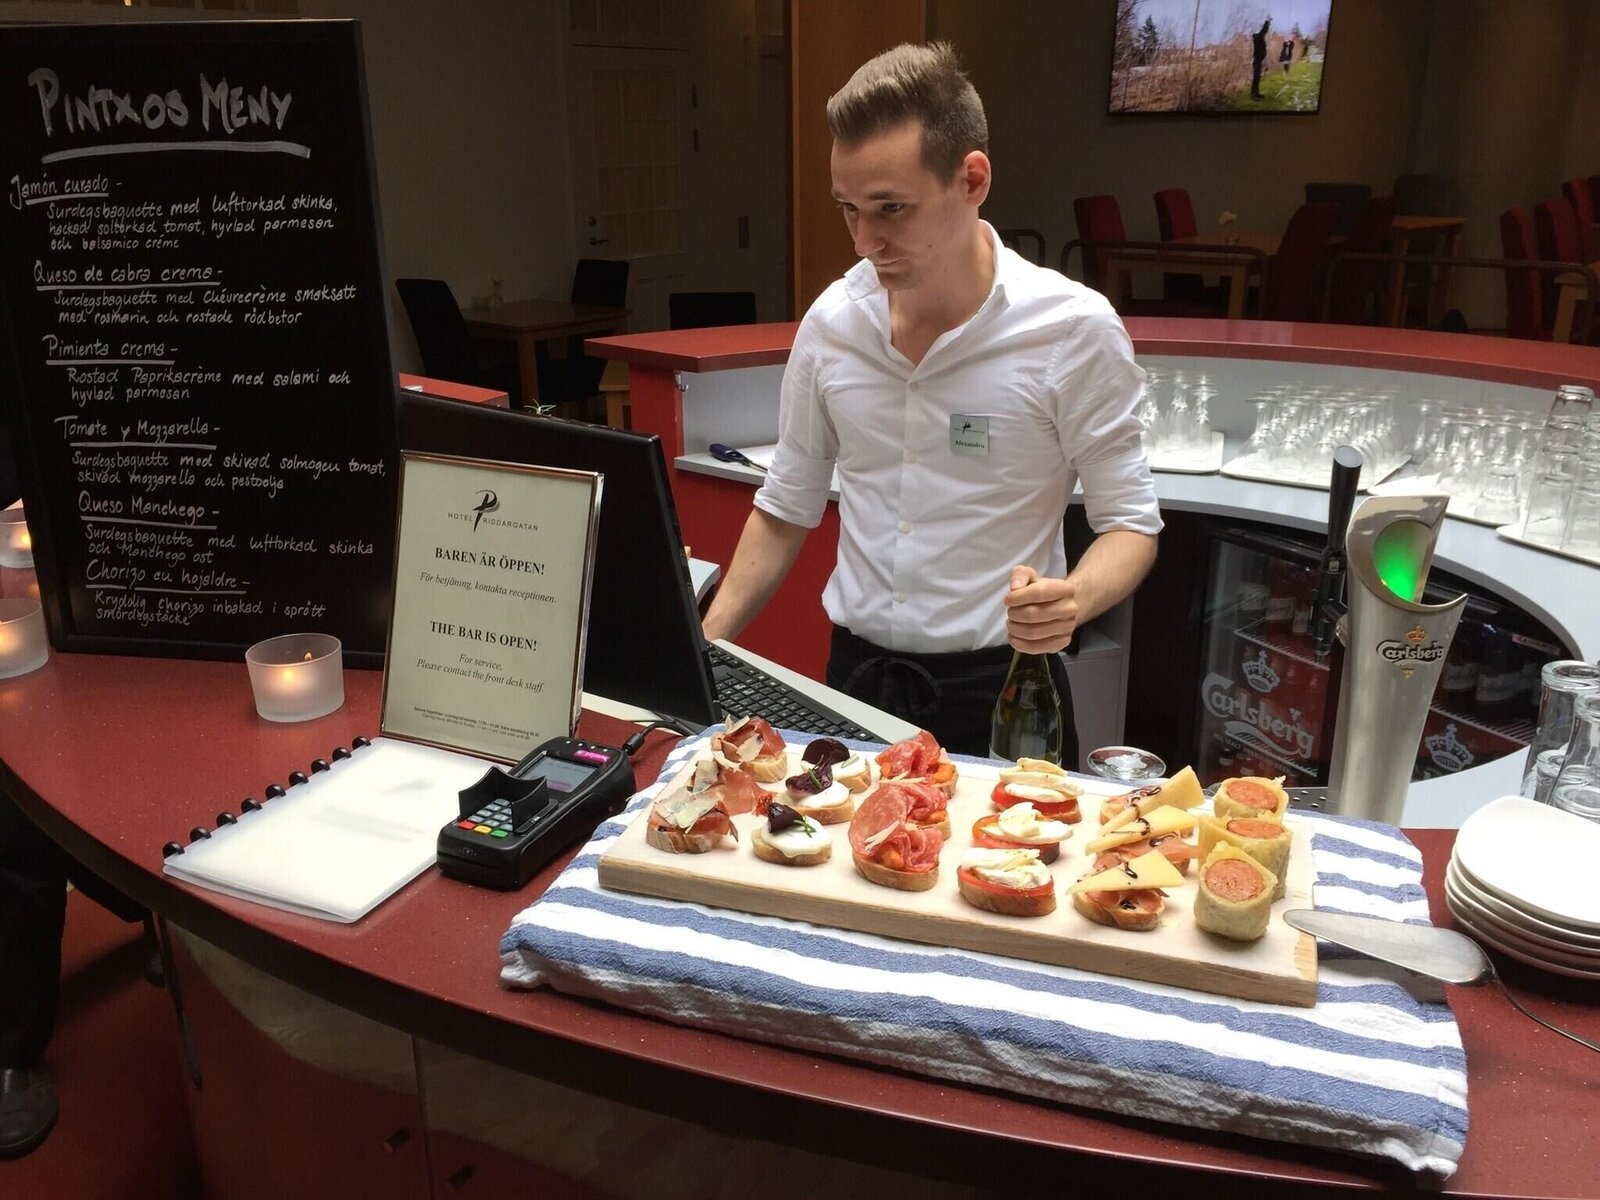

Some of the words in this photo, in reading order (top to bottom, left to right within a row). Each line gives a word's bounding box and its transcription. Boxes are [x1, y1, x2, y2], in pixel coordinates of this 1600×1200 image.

[28, 67, 189, 136] PINTXOS
[201, 73, 292, 134] MENY
[10, 173, 57, 210] Jamón
[170, 198, 200, 215] med
[212, 191, 285, 216] lufttorkad
[97, 221, 157, 235] soltorkad
[211, 218, 256, 238] hyvlad
[263, 218, 334, 235] parmesan
[51, 238, 72, 250] och
[34, 260, 77, 284] Queso
[84, 264, 103, 282] de
[111, 263, 151, 282] cabra
[166, 291, 195, 304] med
[294, 284, 357, 302] smaksatt
[59, 311, 87, 323] med
[157, 309, 179, 322] och
[186, 310, 233, 323] rostade
[42, 334, 109, 357] Pimienta
[67, 367, 119, 384] Rostad
[232, 371, 265, 385] med
[273, 369, 320, 387] salami
[328, 370, 350, 384] och
[71, 386, 115, 407] hyvlad
[126, 387, 190, 402] parmesan
[54, 415, 107, 440] Tomate
[180, 454, 213, 467] med
[224, 452, 270, 469] skivad
[78, 468, 121, 484] skivad
[205, 473, 225, 487] och
[78, 490, 123, 513] Queso
[131, 496, 205, 526] Manchego
[448, 513, 472, 522] HOTEL
[483, 517, 538, 531] RIDDARGATAN
[88, 541, 111, 554] och
[193, 551, 214, 564] ost
[207, 534, 236, 548] med
[329, 540, 374, 554] skinka
[435, 547, 477, 563] BAREN
[479, 552, 496, 567] ÄR
[499, 555, 545, 575] ÖPPEN!
[420, 572, 434, 582] För
[475, 581, 507, 595] kontakta
[508, 589, 557, 603] receptionen.
[213, 599, 263, 615] inbakad
[430, 621, 456, 636] THE
[458, 626, 482, 642] BAR
[485, 631, 497, 644] IS
[500, 633, 537, 652] OPEN!
[459, 653, 473, 664] For
[1376, 639, 1444, 662] Carlsberg
[417, 658, 442, 672] Please
[443, 665, 472, 678] contact
[472, 670, 483, 681] the
[483, 672, 504, 684] front
[505, 677, 523, 689] desk
[1202, 672, 1314, 759] Carlsberg
